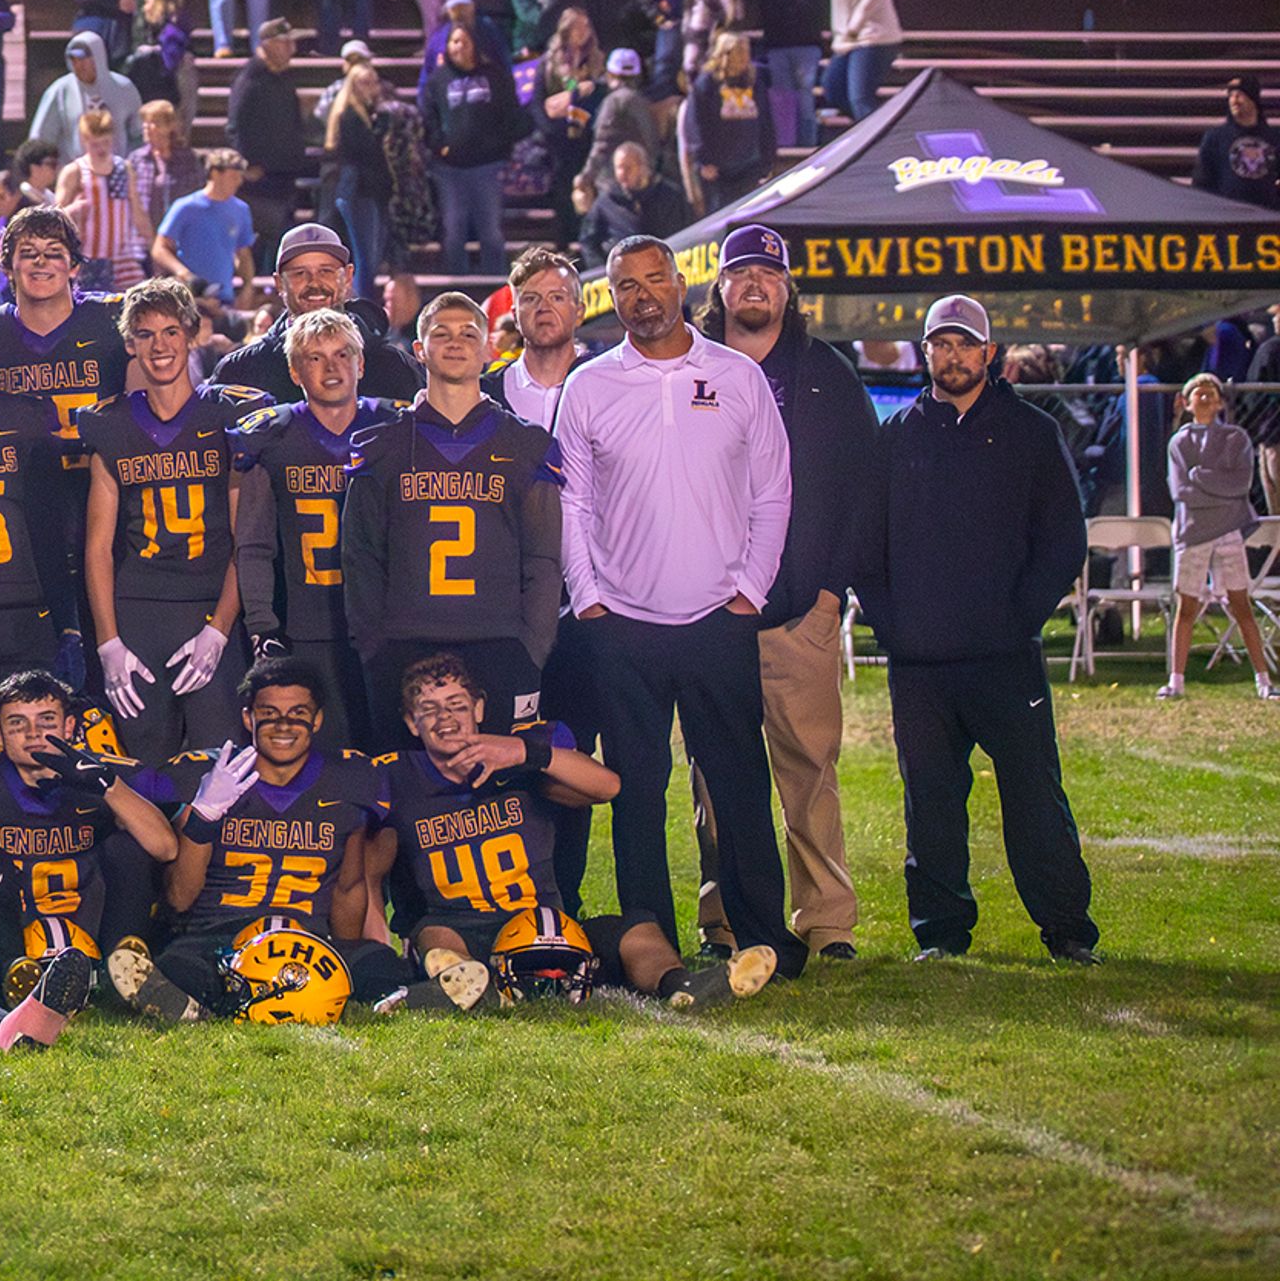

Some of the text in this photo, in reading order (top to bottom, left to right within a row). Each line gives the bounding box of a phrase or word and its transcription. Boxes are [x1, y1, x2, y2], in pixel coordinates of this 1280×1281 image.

[886, 154, 1065, 193] Bengals
[1061, 232, 1280, 273] BENGALS
[693, 379, 717, 401] L
[116, 450, 221, 486] BENGALS
[286, 465, 348, 494] BENG
[399, 471, 506, 504] BENGALS
[139, 483, 206, 560] 14
[294, 498, 344, 586] 2
[428, 505, 477, 596] 2
[220, 818, 336, 851] BENGALS
[415, 797, 524, 849] BENGALS
[218, 850, 329, 915] 32
[427, 832, 540, 913] 48
[267, 939, 339, 983] LHS
